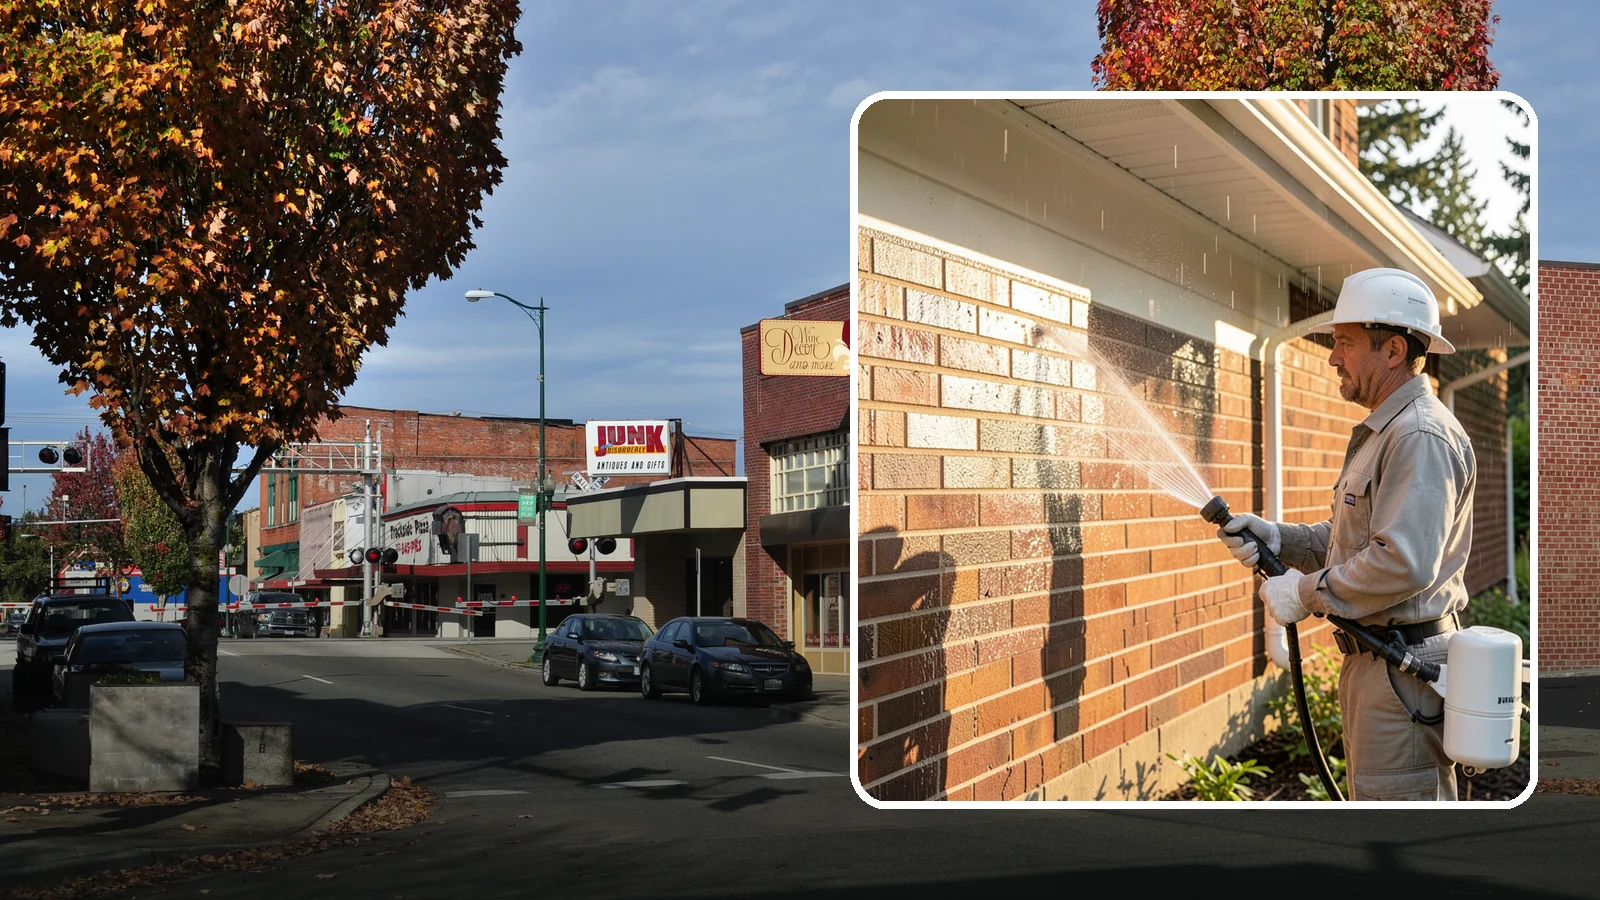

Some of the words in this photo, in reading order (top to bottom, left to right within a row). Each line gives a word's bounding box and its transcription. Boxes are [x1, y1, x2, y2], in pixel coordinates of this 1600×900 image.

[595, 425, 665, 457] JUNK
[607, 446, 646, 454] DISORDERLY
[596, 460, 628, 470] ANTIQUES
[630, 460, 644, 470] AND
[647, 460, 665, 470] GIFTS
[390, 521, 413, 540] Trackside
[414, 519, 429, 535] Pizza
